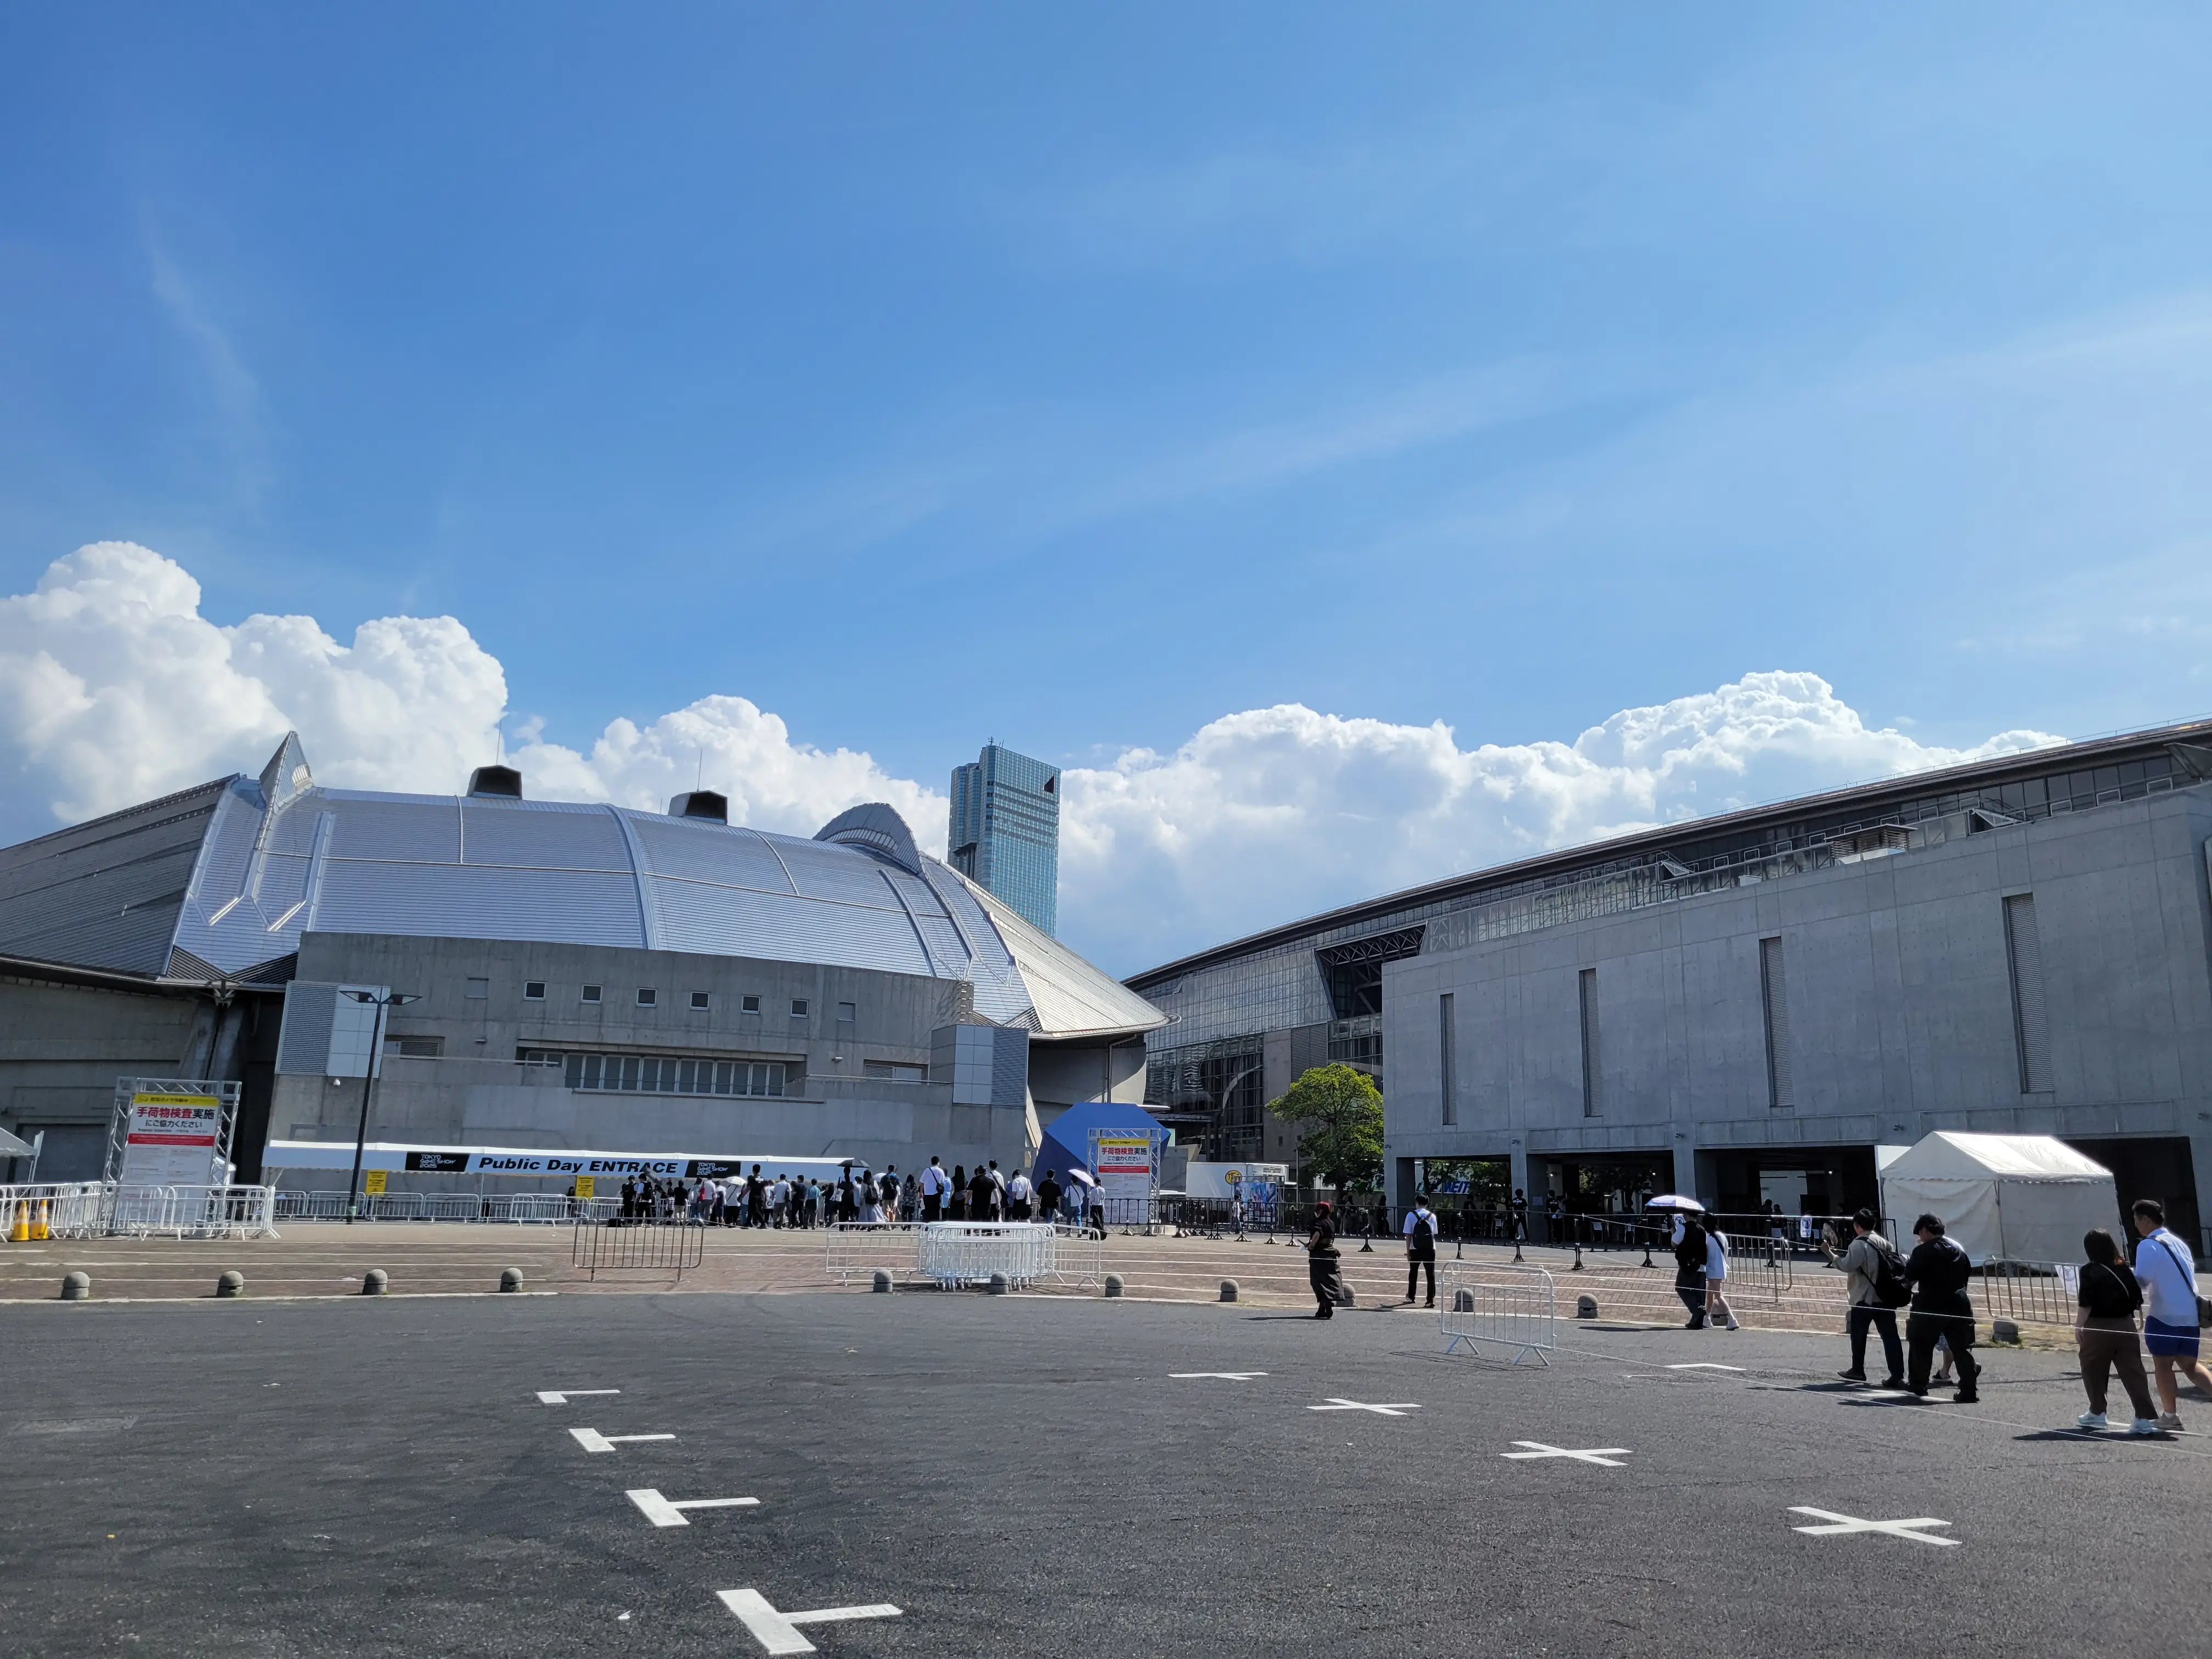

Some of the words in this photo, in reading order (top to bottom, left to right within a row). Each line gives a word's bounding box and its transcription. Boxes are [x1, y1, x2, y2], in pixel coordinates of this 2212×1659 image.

[137, 1107, 215, 1120] 手荷物検査実施
[145, 1119, 202, 1128] にご協力ください
[479, 1157, 541, 1170] Public
[547, 1159, 584, 1173] Day
[589, 1160, 678, 1173] ENTRACE
